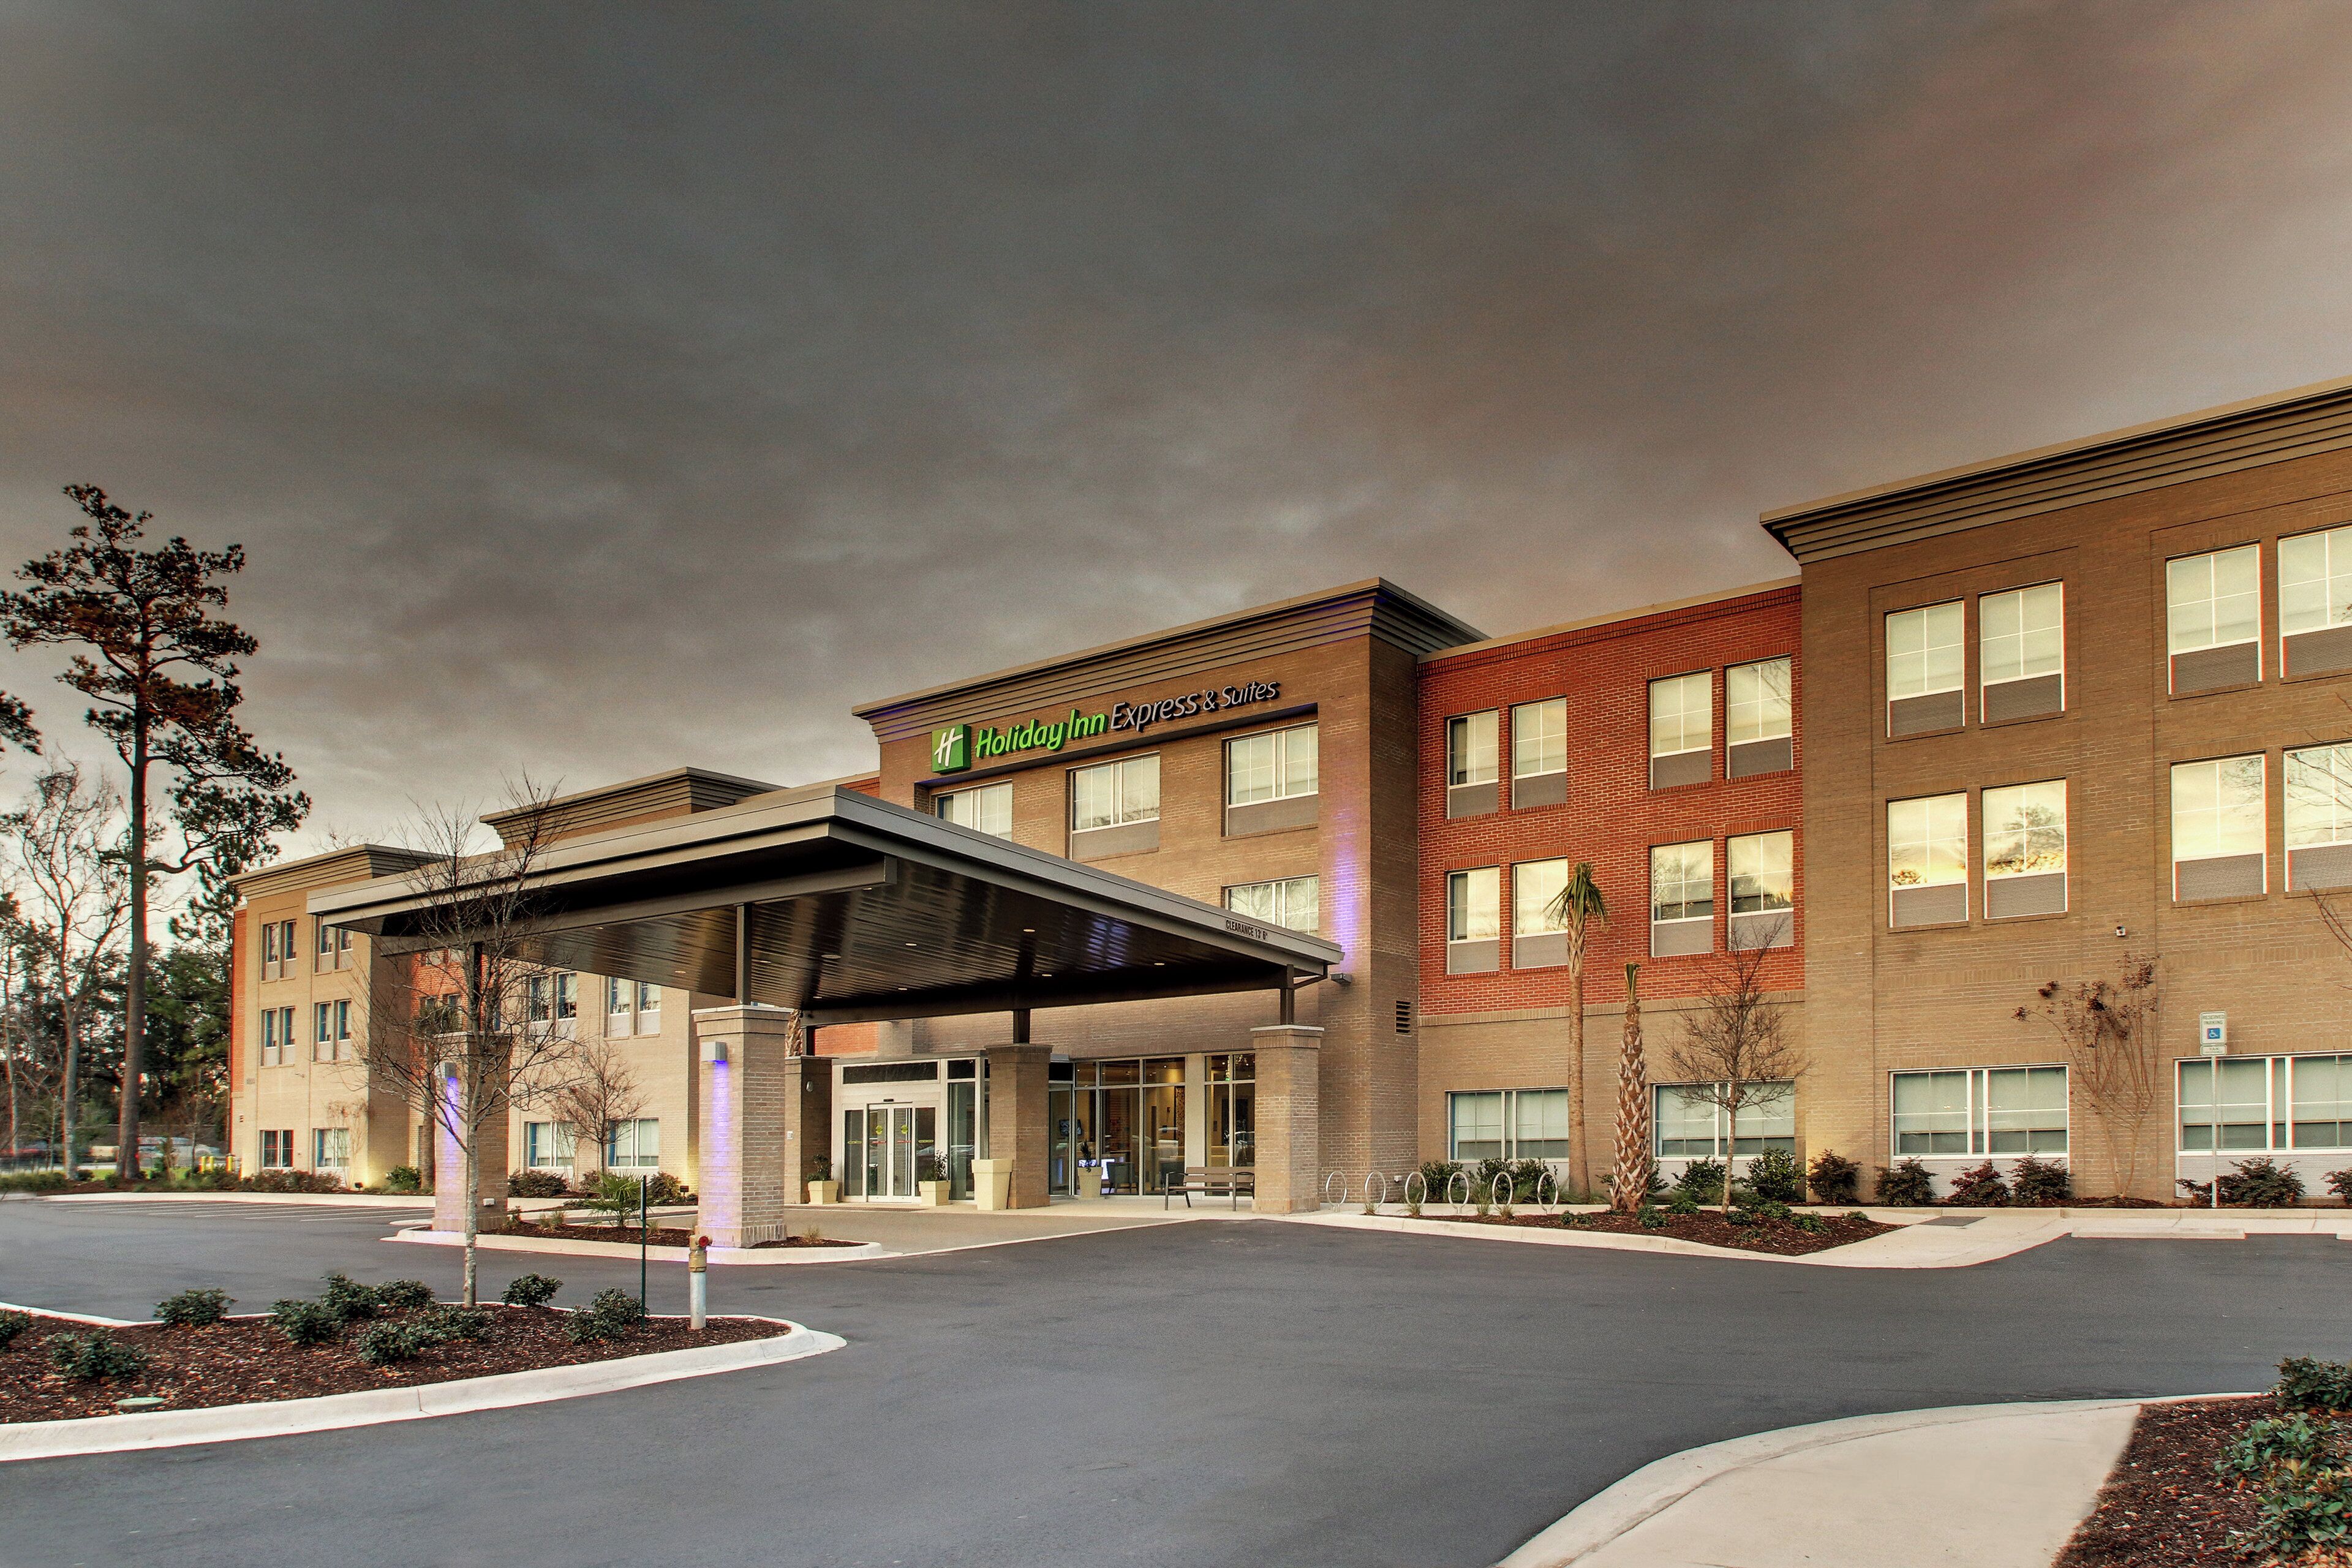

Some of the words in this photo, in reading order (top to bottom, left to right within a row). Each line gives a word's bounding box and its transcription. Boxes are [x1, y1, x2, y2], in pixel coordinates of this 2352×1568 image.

[974, 718, 1066, 758] Holiday
[1068, 709, 1108, 739] Inn
[1110, 693, 1199, 731] Express
[1202, 690, 1216, 710] &
[1220, 681, 1278, 707] Suites
[1226, 919, 1254, 937] CLEARANCE
